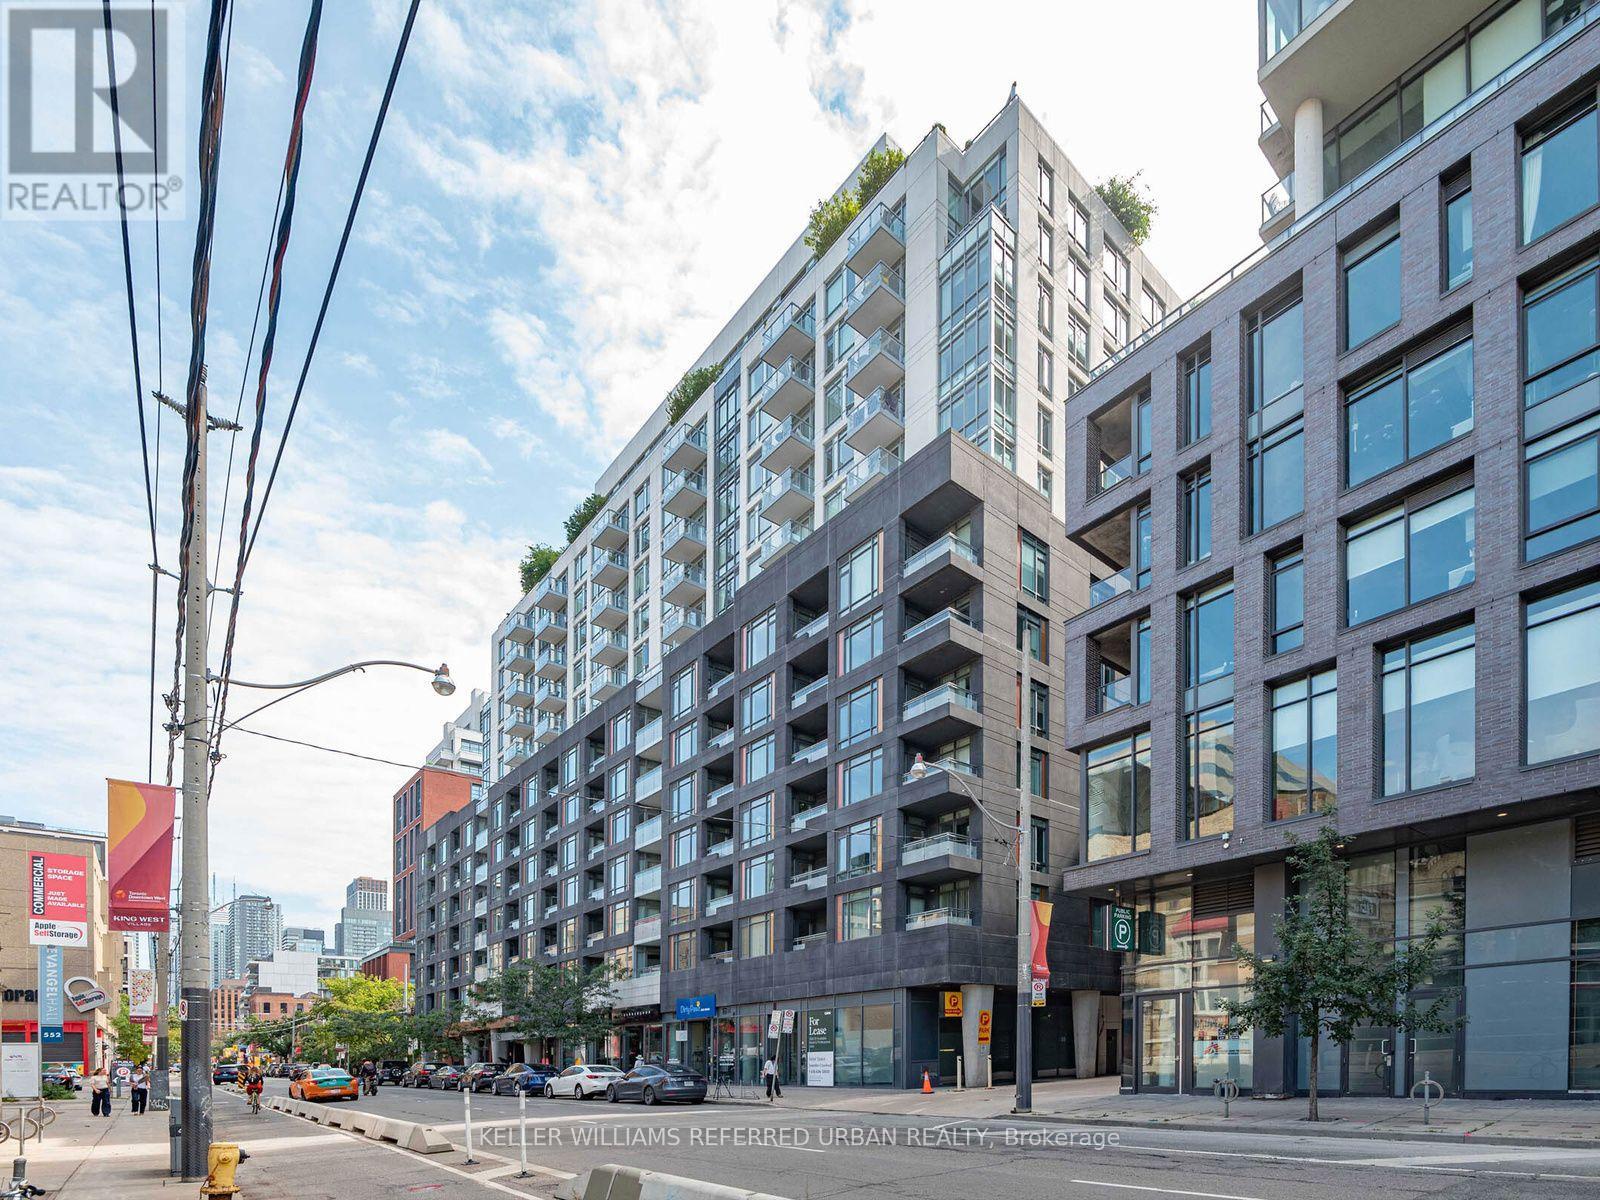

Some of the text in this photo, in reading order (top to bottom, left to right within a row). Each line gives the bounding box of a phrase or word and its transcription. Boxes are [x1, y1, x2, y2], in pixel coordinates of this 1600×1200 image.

[47, 868, 84, 876] STORAGE
[33, 857, 44, 915] COMMERCIAL
[47, 901, 85, 909] AVAILABLE
[1115, 907, 1131, 915] PUBLIC
[1113, 912, 1132, 920] PARKING
[34, 922, 57, 931] Apple
[1119, 924, 1127, 940] P
[2, 988, 38, 1003] ora
[809, 1016, 820, 1026] For
[809, 1027, 827, 1035] Lease
